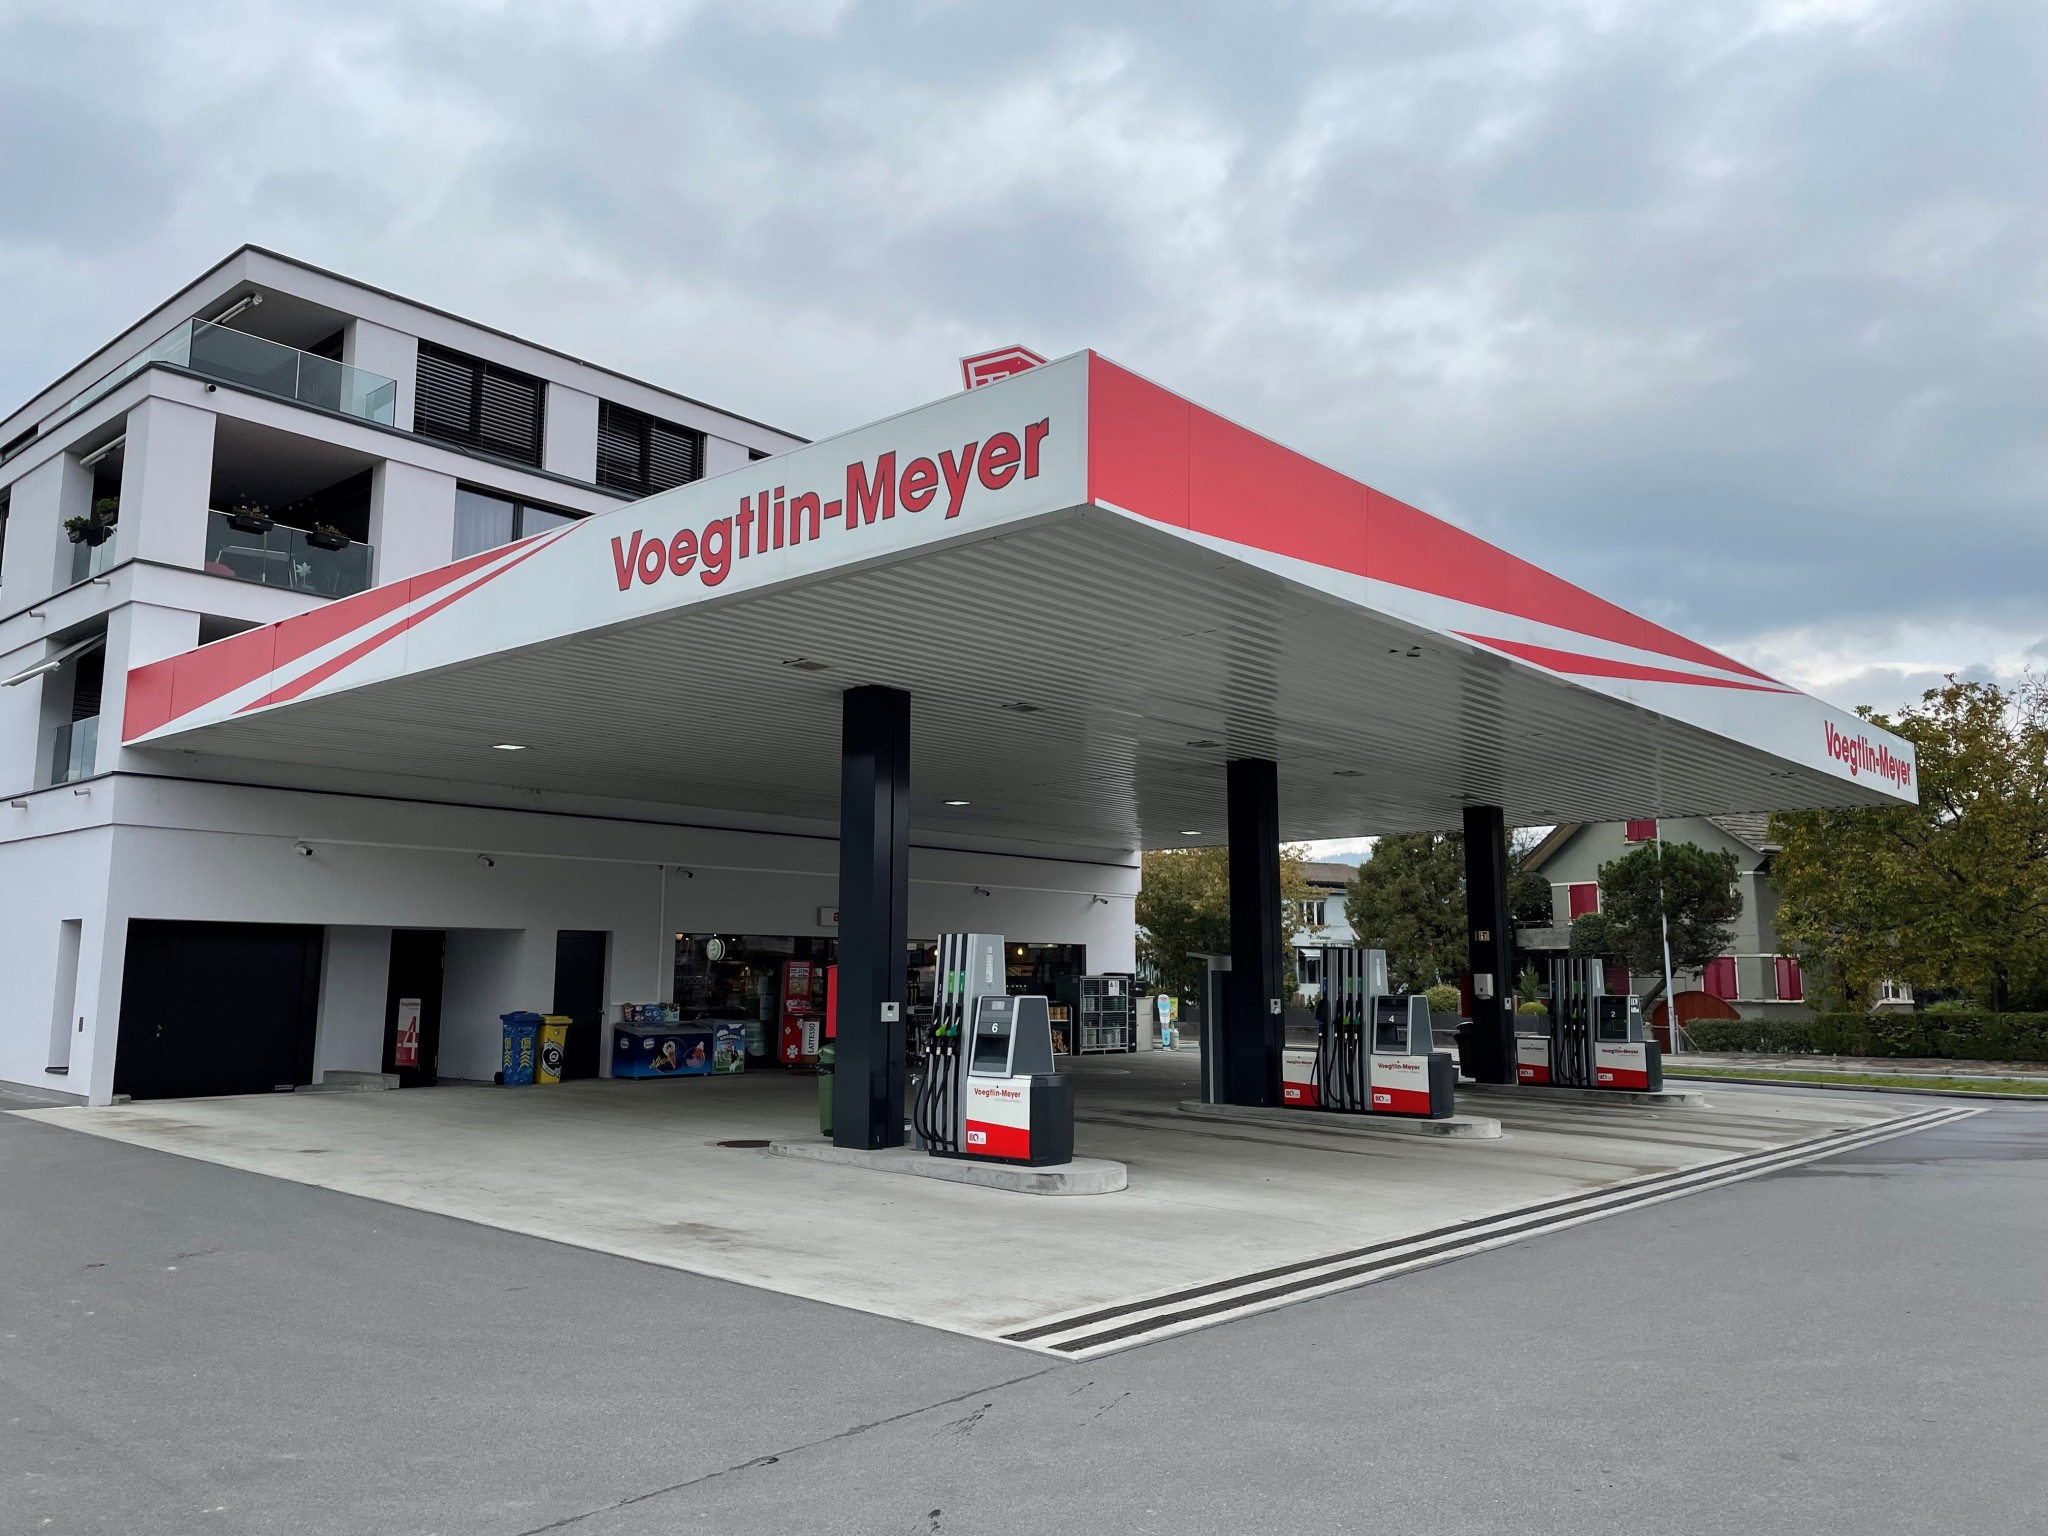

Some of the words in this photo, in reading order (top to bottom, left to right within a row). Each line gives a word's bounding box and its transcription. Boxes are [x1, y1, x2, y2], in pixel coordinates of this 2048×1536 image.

[611, 416, 1050, 592] Voegtlin-Meyer
[1825, 720, 1911, 789] Voegtlin-Meyer
[1610, 1010, 1616, 1018] 2
[807, 1022, 816, 1054] LATTESSO
[991, 1022, 999, 1033] 6
[974, 1087, 1021, 1099] Voegtlin-Meyer
